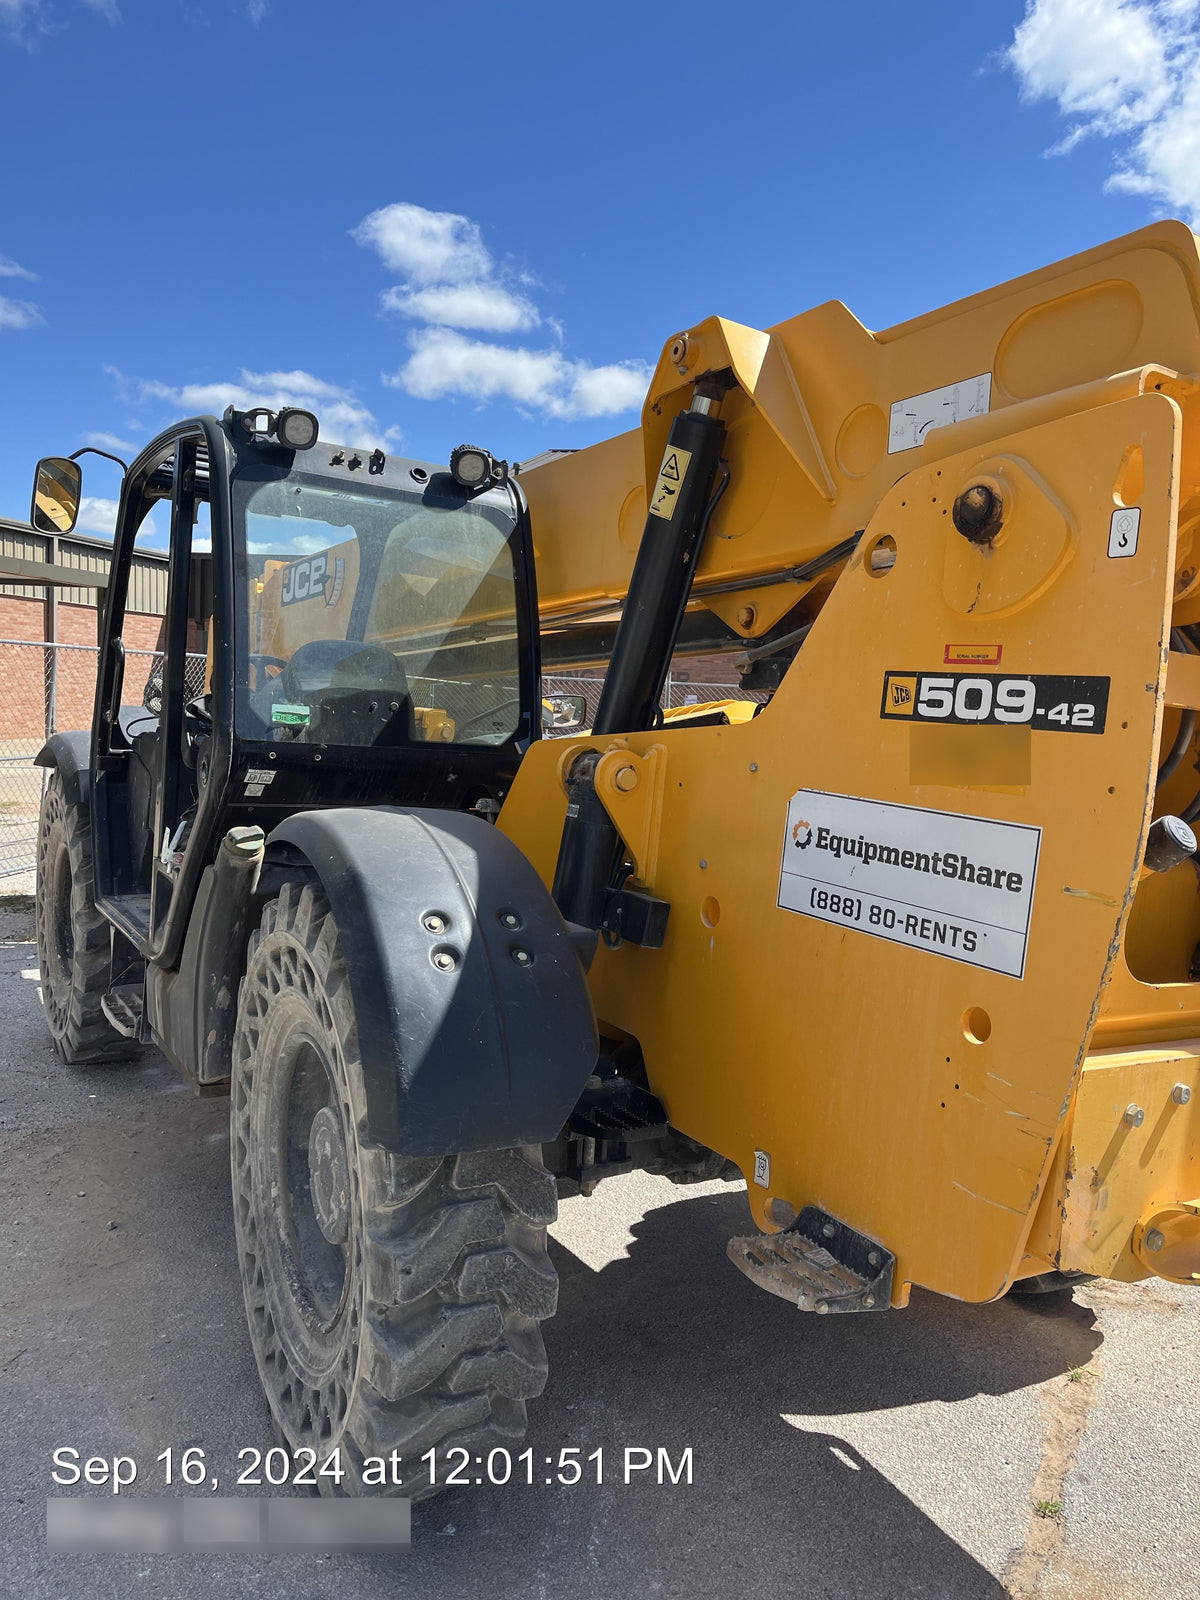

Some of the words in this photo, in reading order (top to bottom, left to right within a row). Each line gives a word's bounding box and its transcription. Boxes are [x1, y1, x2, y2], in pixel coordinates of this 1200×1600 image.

[282, 557, 326, 603] JCB
[893, 685, 911, 705] JCB
[917, 677, 1095, 727] 509-42
[815, 826, 1023, 893] EquipmentShare
[810, 887, 862, 921] (888)
[869, 904, 978, 953] 80-RENTS
